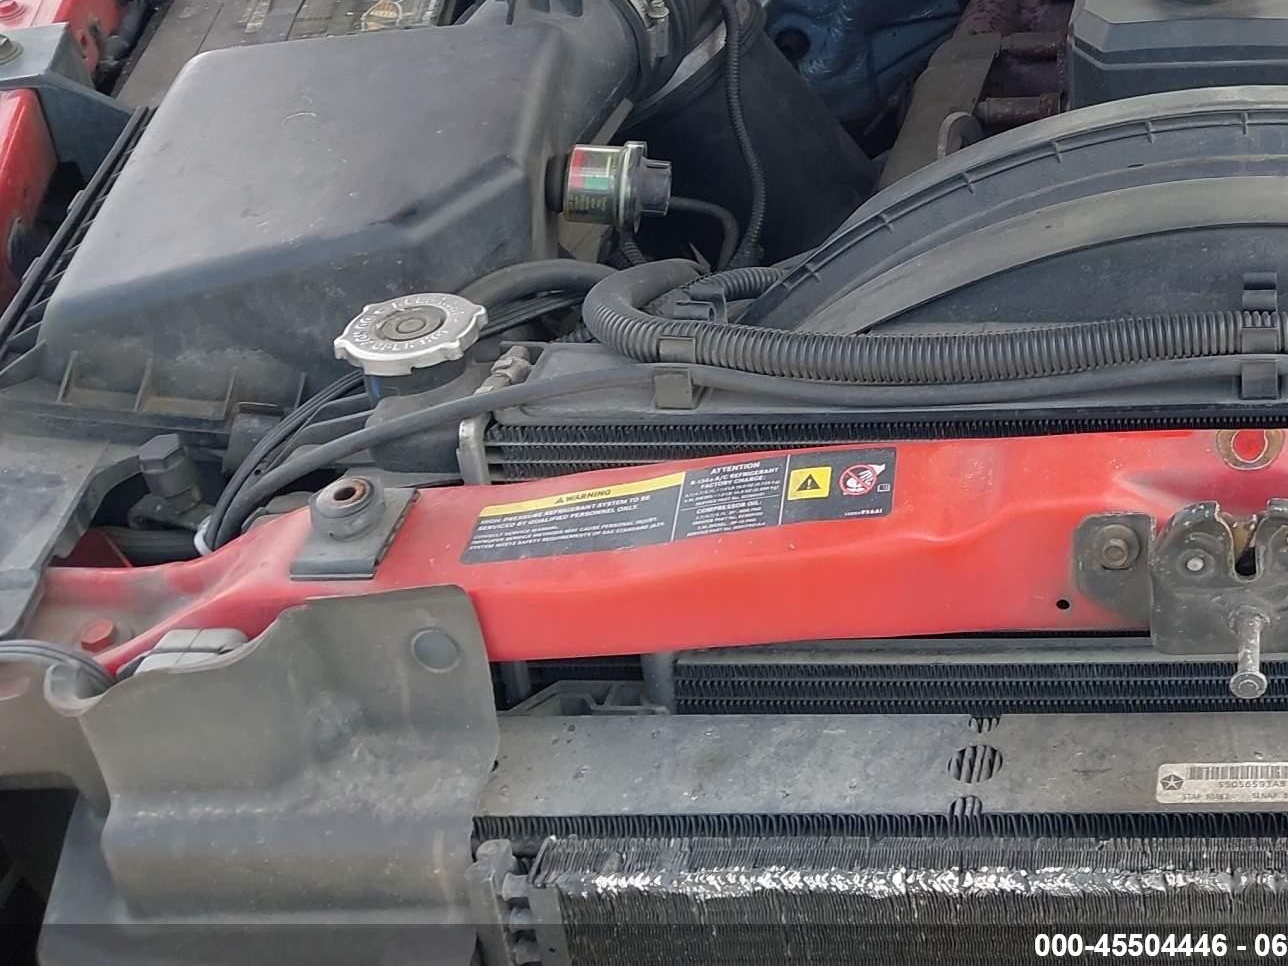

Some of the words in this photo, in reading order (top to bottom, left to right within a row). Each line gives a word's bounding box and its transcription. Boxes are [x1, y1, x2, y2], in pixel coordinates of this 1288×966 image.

[710, 461, 761, 475] ATTENTION
[729, 467, 779, 478] REFRIGERANT
[566, 489, 611, 501] WARNING
[597, 499, 628, 508] SYSTEM
[696, 501, 746, 514] COMPRESSOR
[477, 522, 516, 531] SERVICED
[527, 514, 569, 525] QUALIFIED
[570, 508, 616, 518] PERSONNEL
